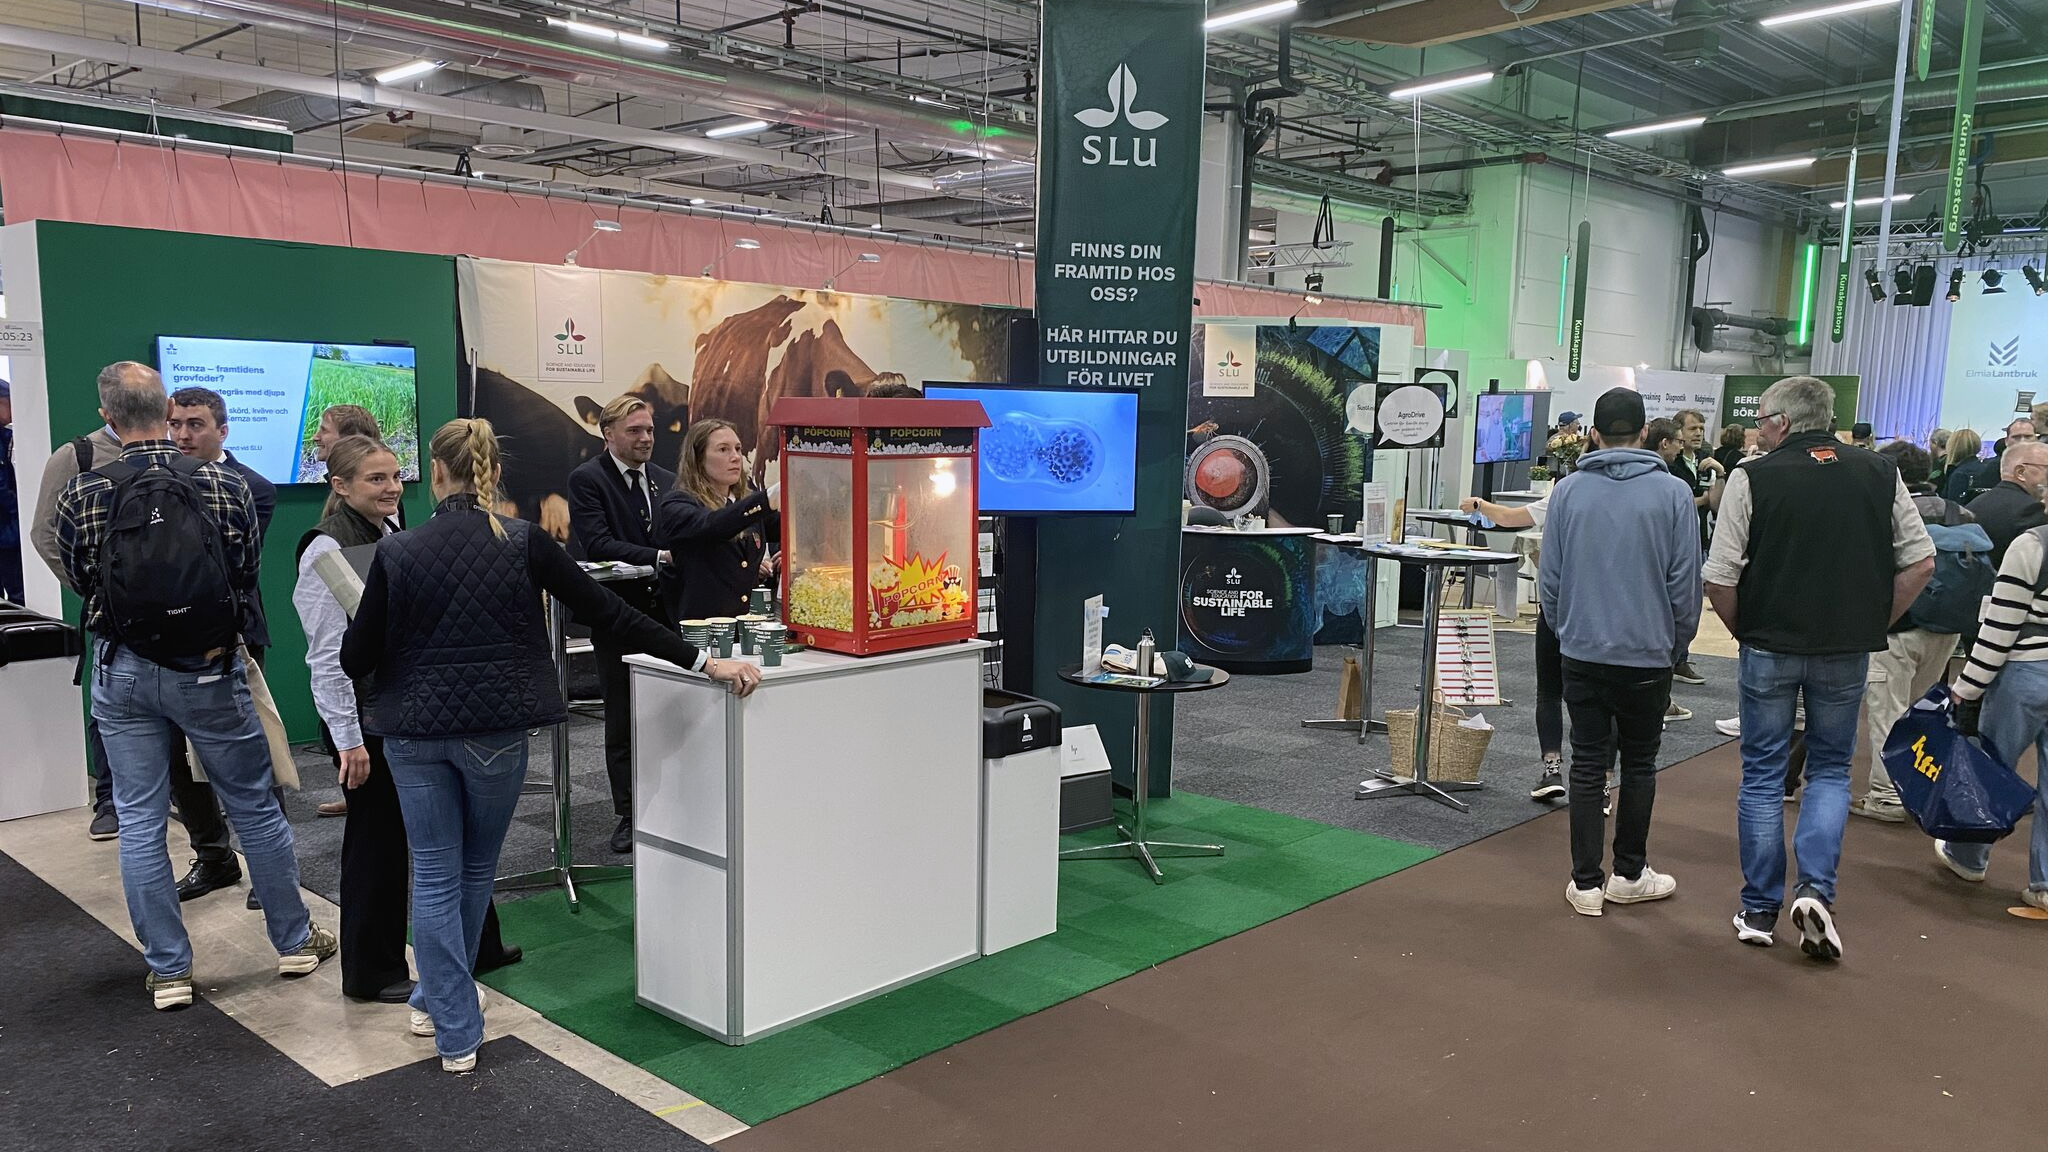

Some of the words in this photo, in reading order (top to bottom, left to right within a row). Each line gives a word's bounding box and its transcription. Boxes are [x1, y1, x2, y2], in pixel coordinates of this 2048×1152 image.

[1082, 135, 1157, 167] SLU
[1949, 114, 1971, 232] Kunskapstorg
[1070, 242, 1125, 259] FINNS
[1130, 244, 1162, 260] DIN
[1054, 264, 1133, 280] FRAMTID
[1137, 267, 1176, 281] HOS
[1090, 286, 1138, 302] OSS?
[1834, 274, 1848, 334] Kunskapstorg
[1046, 325, 1083, 343] HÄR
[1088, 329, 1148, 345] HITTAR
[1152, 331, 1178, 345] DU
[557, 343, 583, 355] SLU
[1570, 319, 1582, 374] Kunskapstorg
[1046, 349, 1177, 366] UTBILDNINGAR
[172, 363, 206, 373] Kernza
[216, 365, 265, 374] framtidens
[1218, 368, 1240, 377] SLU
[173, 374, 225, 383] grovfoder?
[1067, 368, 1103, 386] FÖR
[1108, 372, 1154, 386] LIVET
[263, 389, 286, 397] djupa
[1734, 395, 1760, 405] BERE
[228, 407, 251, 415] skörd,
[1397, 411, 1426, 420] AgroDrive
[804, 428, 850, 437] POPCORN
[890, 428, 942, 437] POPCORN
[883, 576, 945, 606] POPCORN
[1240, 590, 1264, 600] FOR
[1193, 597, 1273, 609] SUSTAINABLE
[166, 606, 192, 615] TIGHT
[1220, 607, 1246, 617] LIFE
